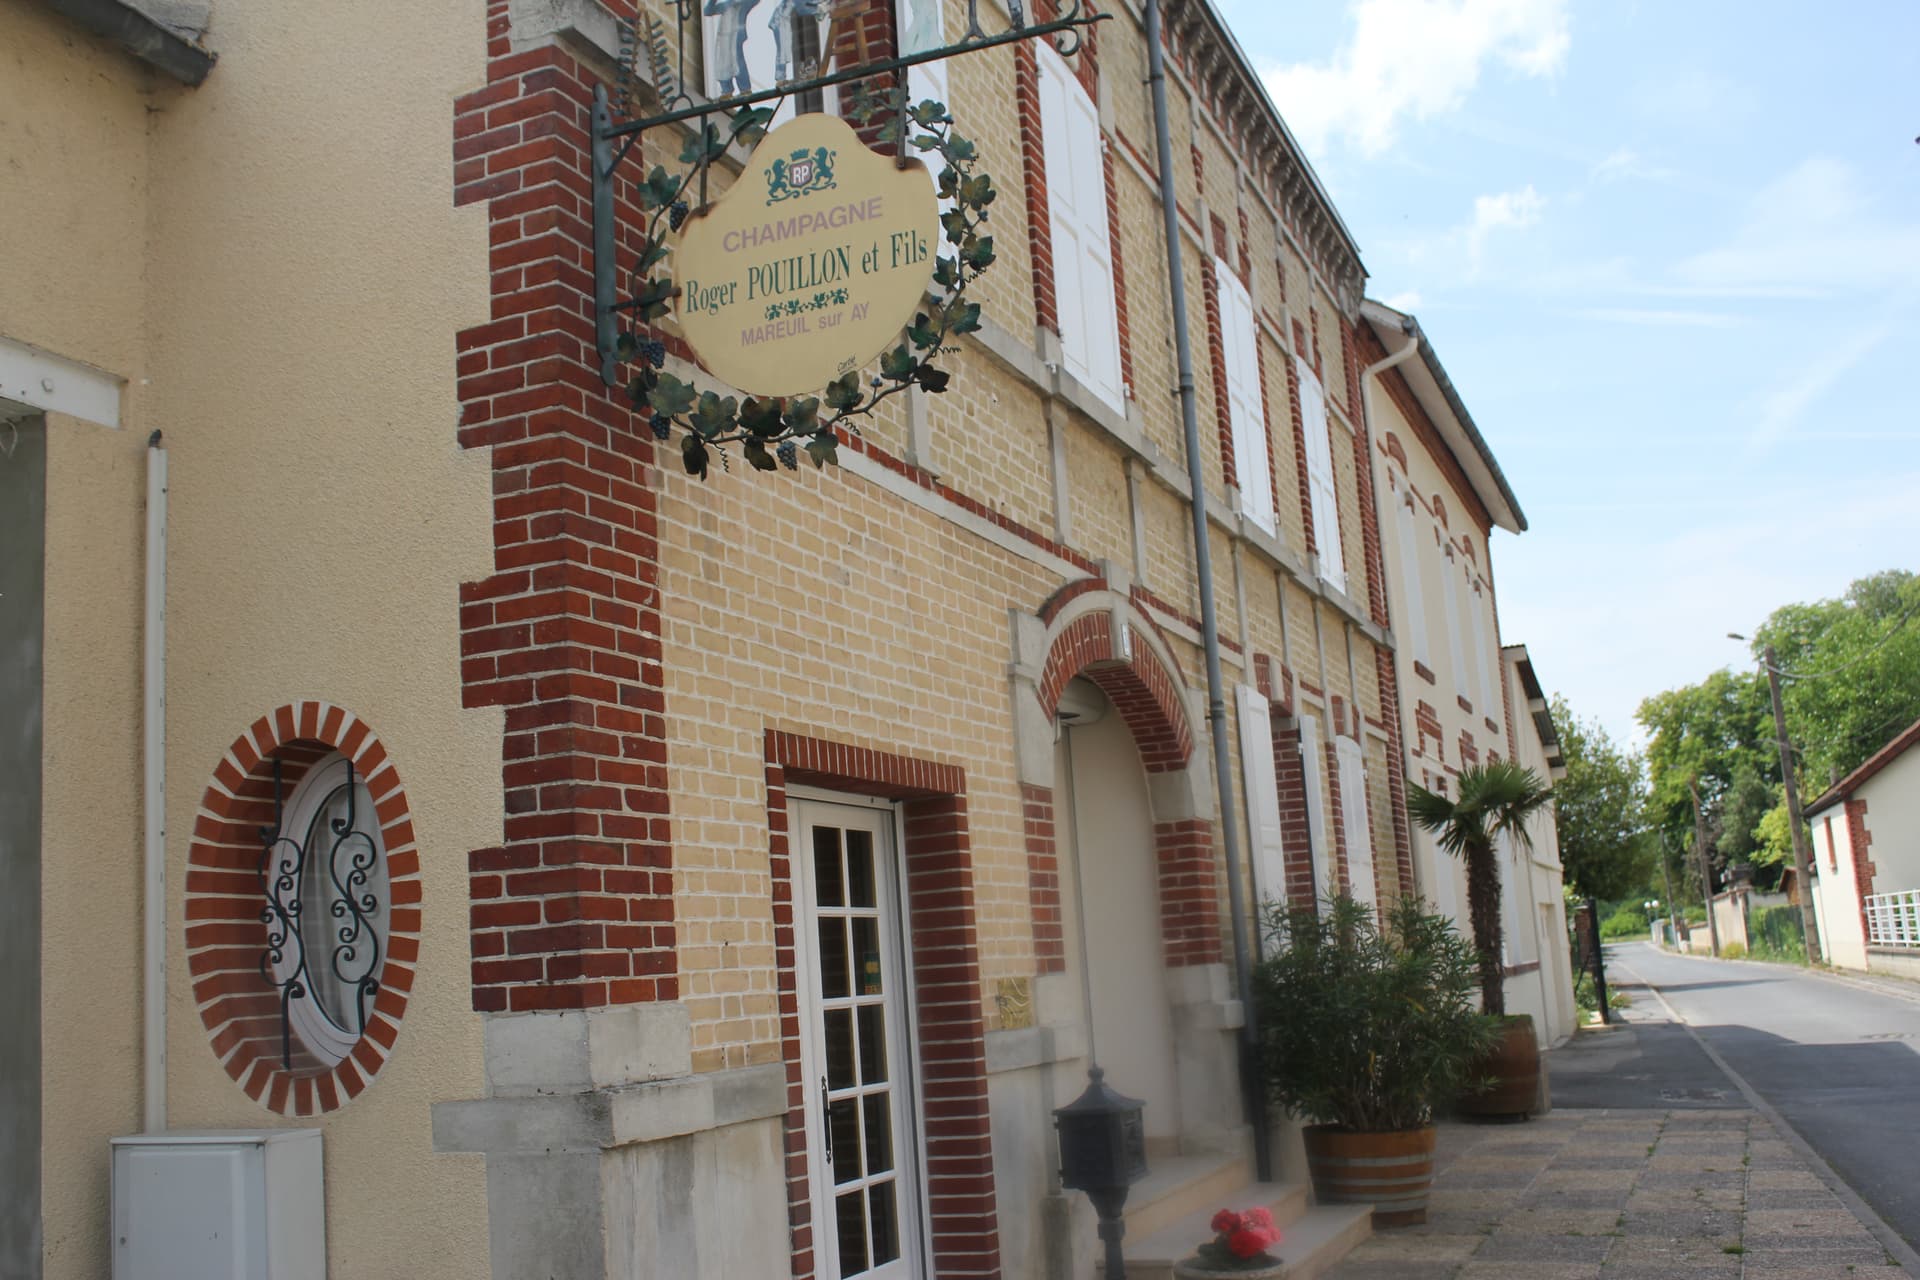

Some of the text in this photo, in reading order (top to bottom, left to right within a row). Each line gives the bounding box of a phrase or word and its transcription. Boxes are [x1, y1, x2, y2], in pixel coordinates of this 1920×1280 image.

[793, 165, 809, 184] RP
[723, 197, 883, 253] CHAMPAGNE
[686, 229, 928, 316] Roger POUILLON et Fils
[741, 301, 870, 347] MAREUIL sur AY
